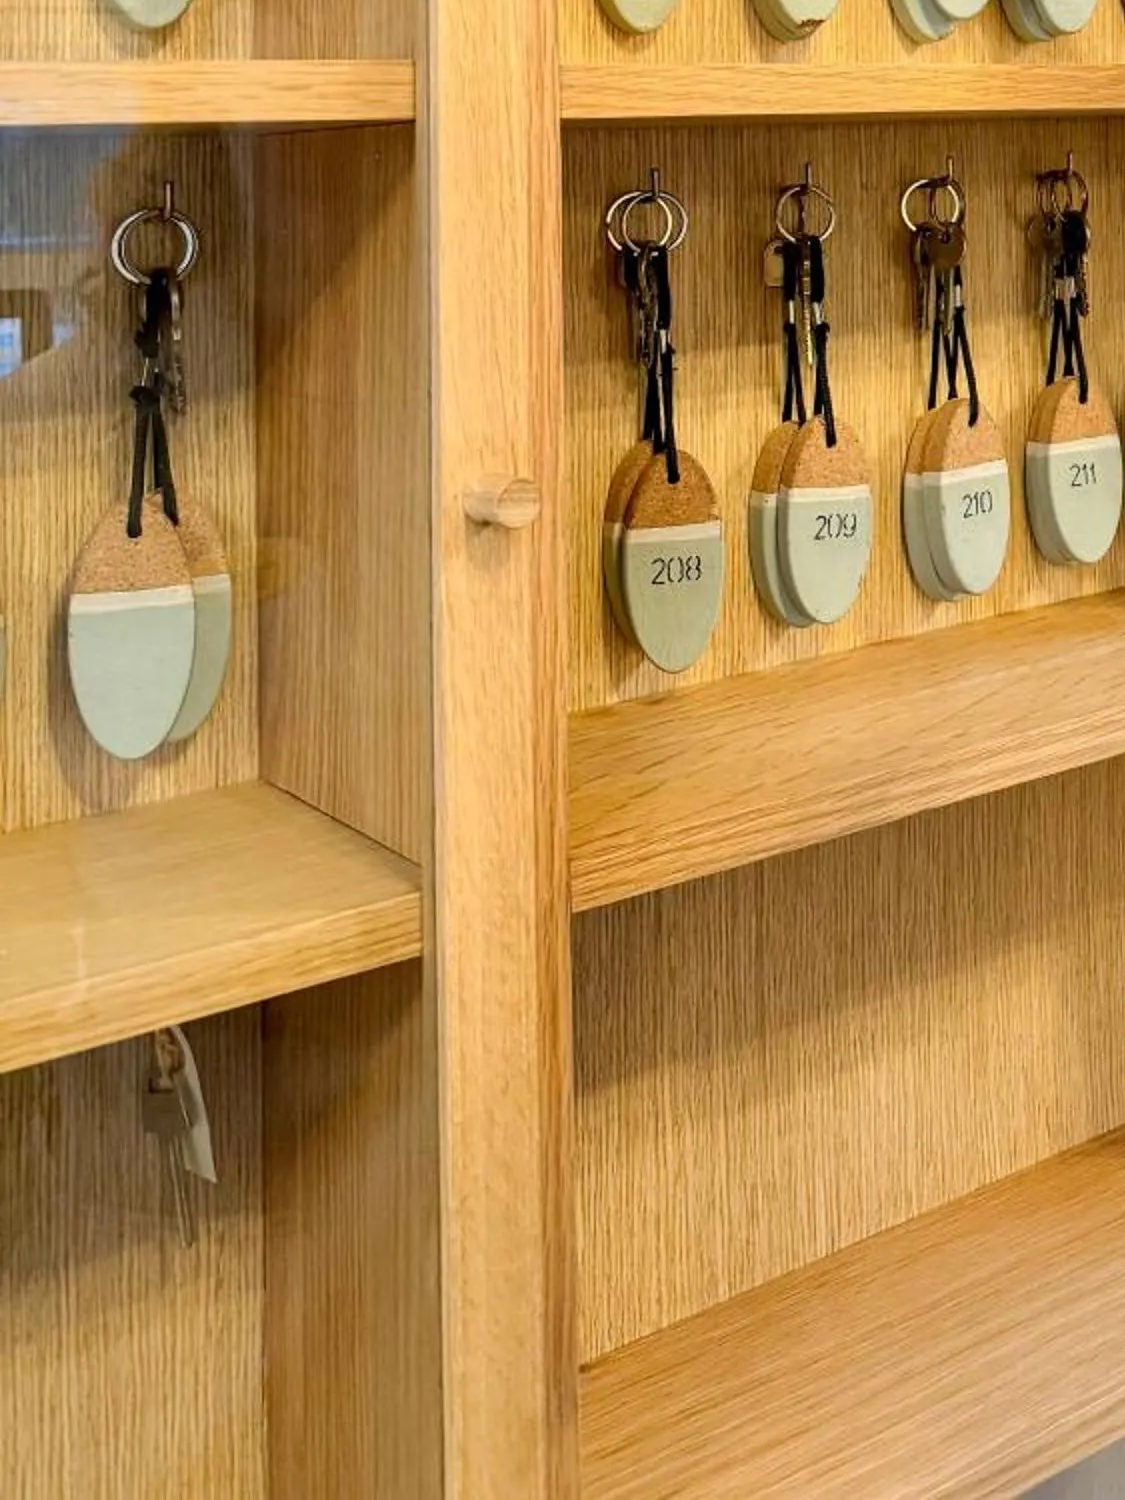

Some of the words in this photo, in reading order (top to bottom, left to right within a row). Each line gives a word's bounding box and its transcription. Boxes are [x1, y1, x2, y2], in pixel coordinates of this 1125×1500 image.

[1069, 463, 1097, 487] 211
[962, 491, 992, 519] 210
[814, 512, 857, 540] 209
[651, 556, 702, 586] 208
